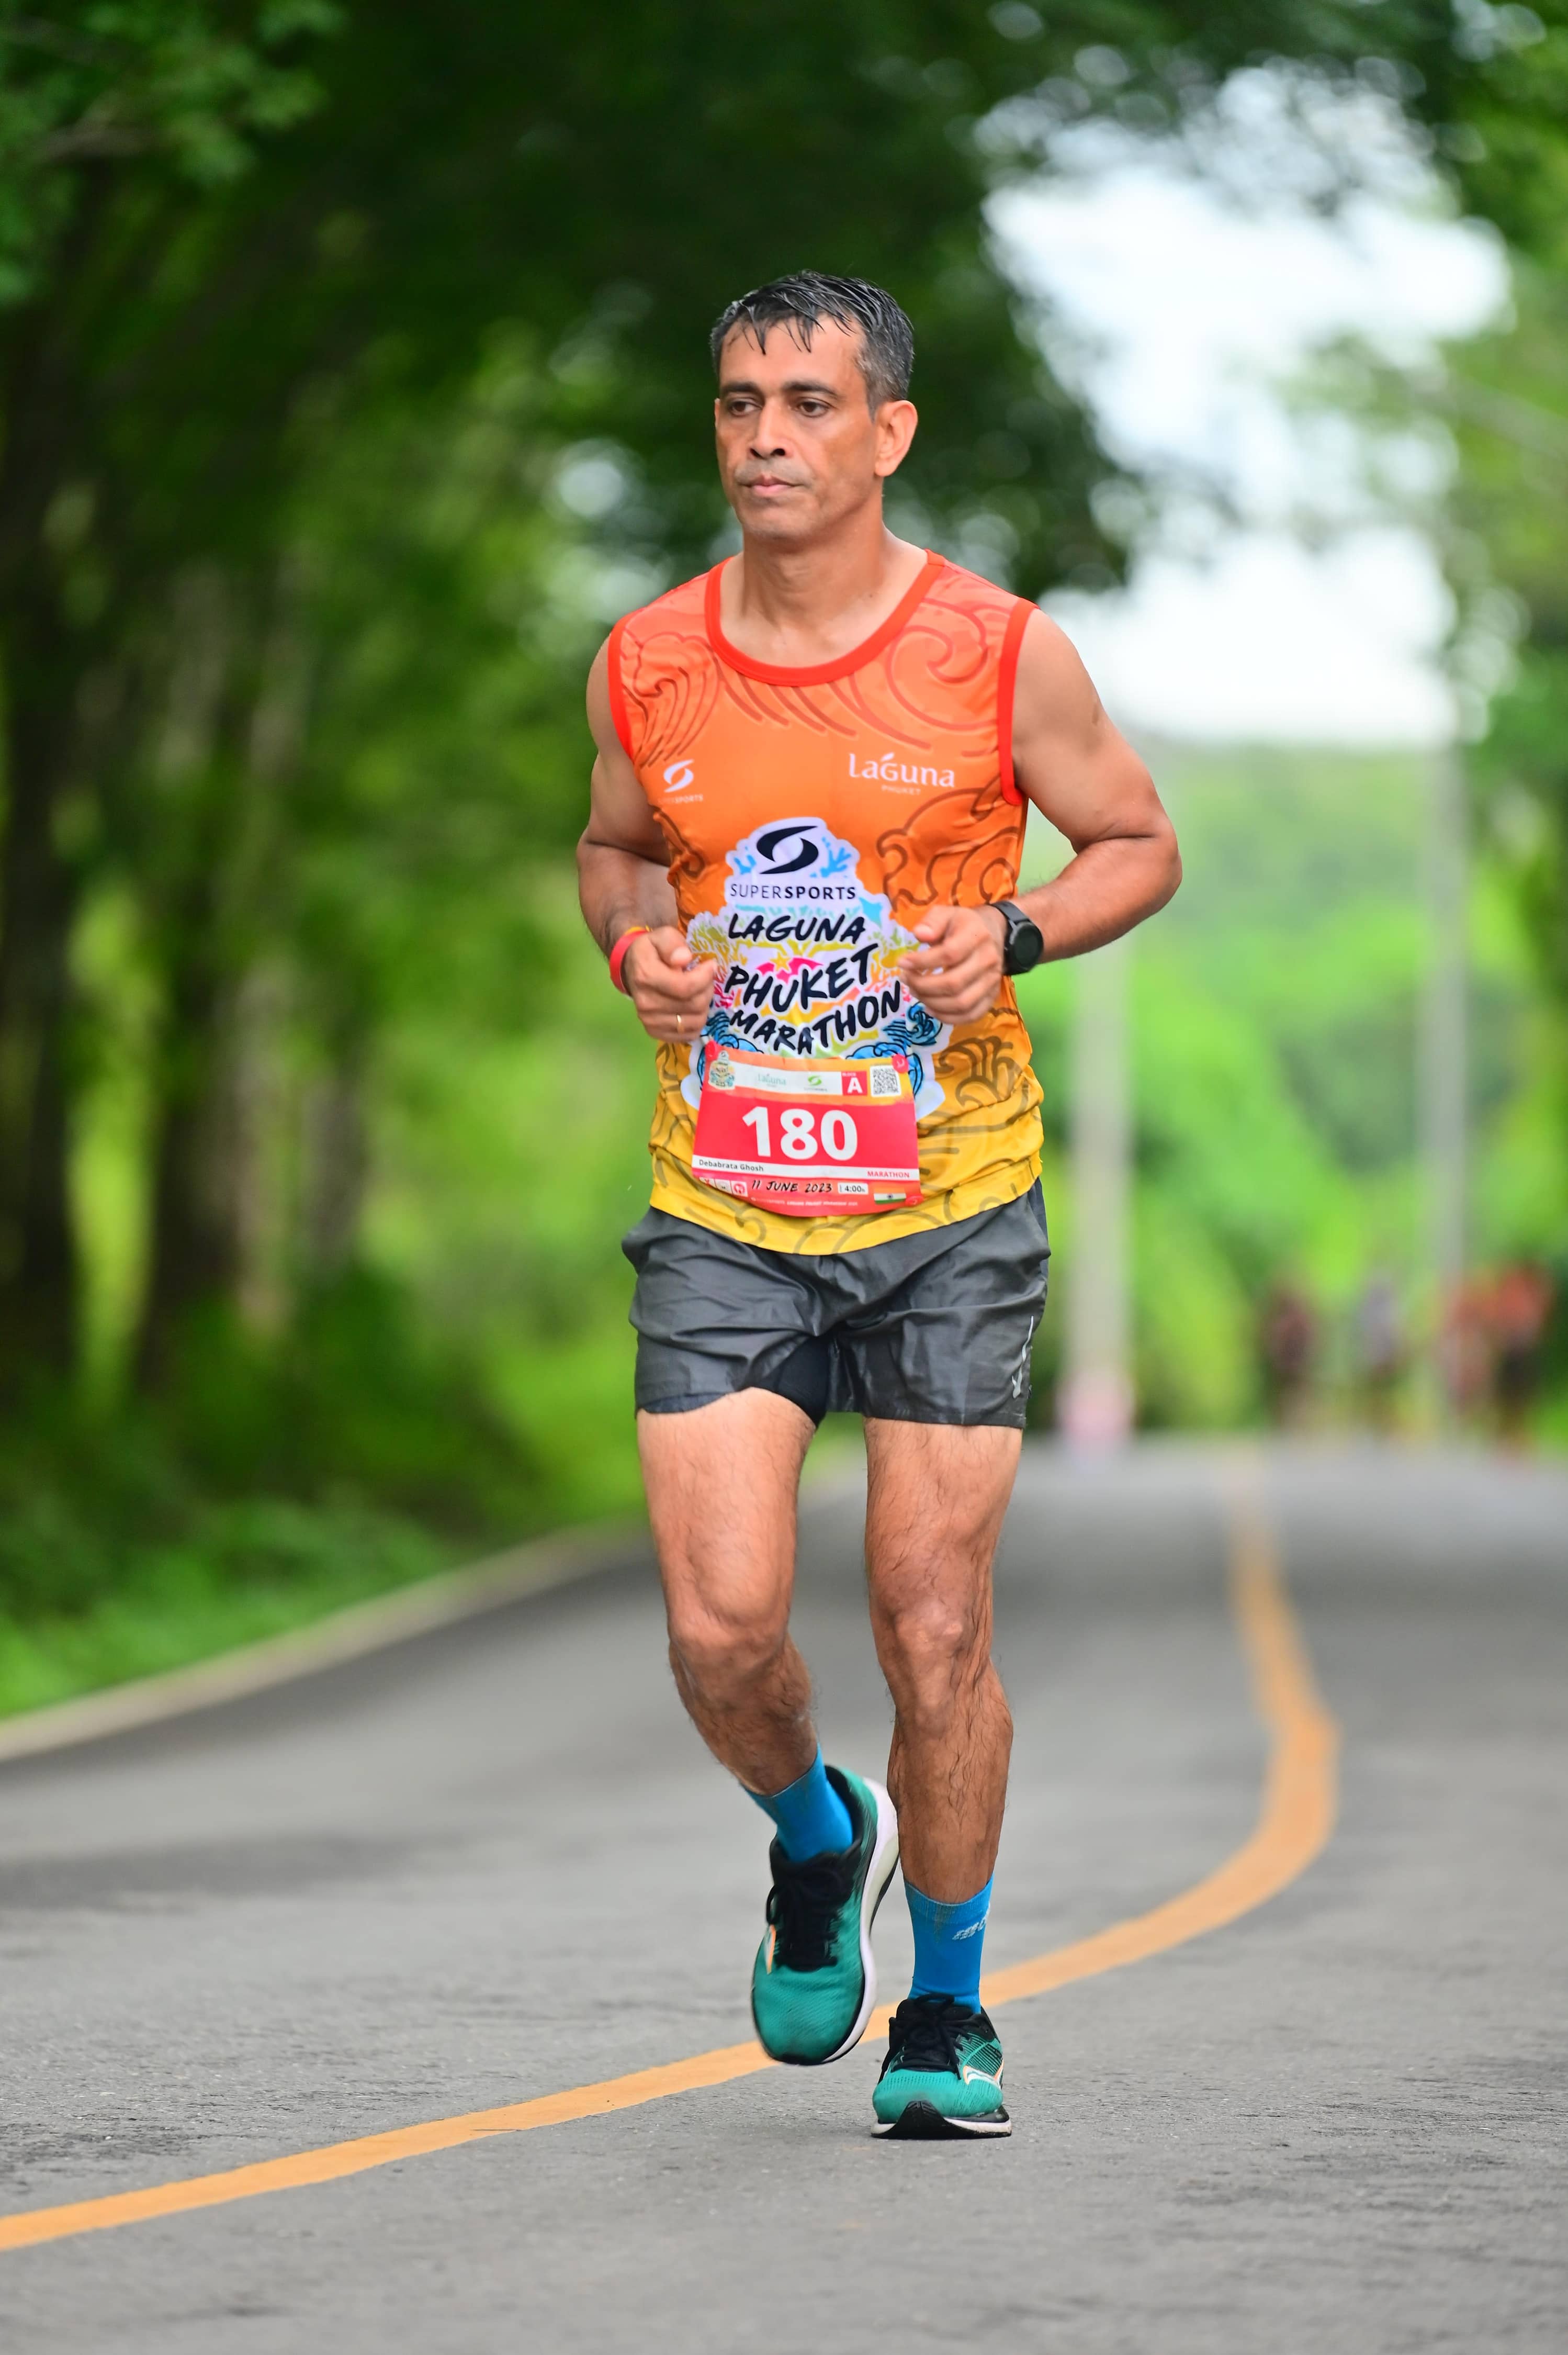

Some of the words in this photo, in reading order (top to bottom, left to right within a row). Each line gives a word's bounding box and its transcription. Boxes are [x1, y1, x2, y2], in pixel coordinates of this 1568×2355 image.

[730, 883, 856, 900] SUPERSPORTS
[728, 913, 866, 944] LAGUNA
[724, 943, 878, 1013] PHUKET
[729, 980, 900, 1055] MARATHON
[847, 1076, 863, 1094] A
[742, 1105, 858, 1161] 180
[699, 1159, 738, 1170] Debabrata
[751, 1180, 761, 1190] 11
[766, 1180, 798, 1192] JUNE
[805, 1182, 832, 1193] 2023
